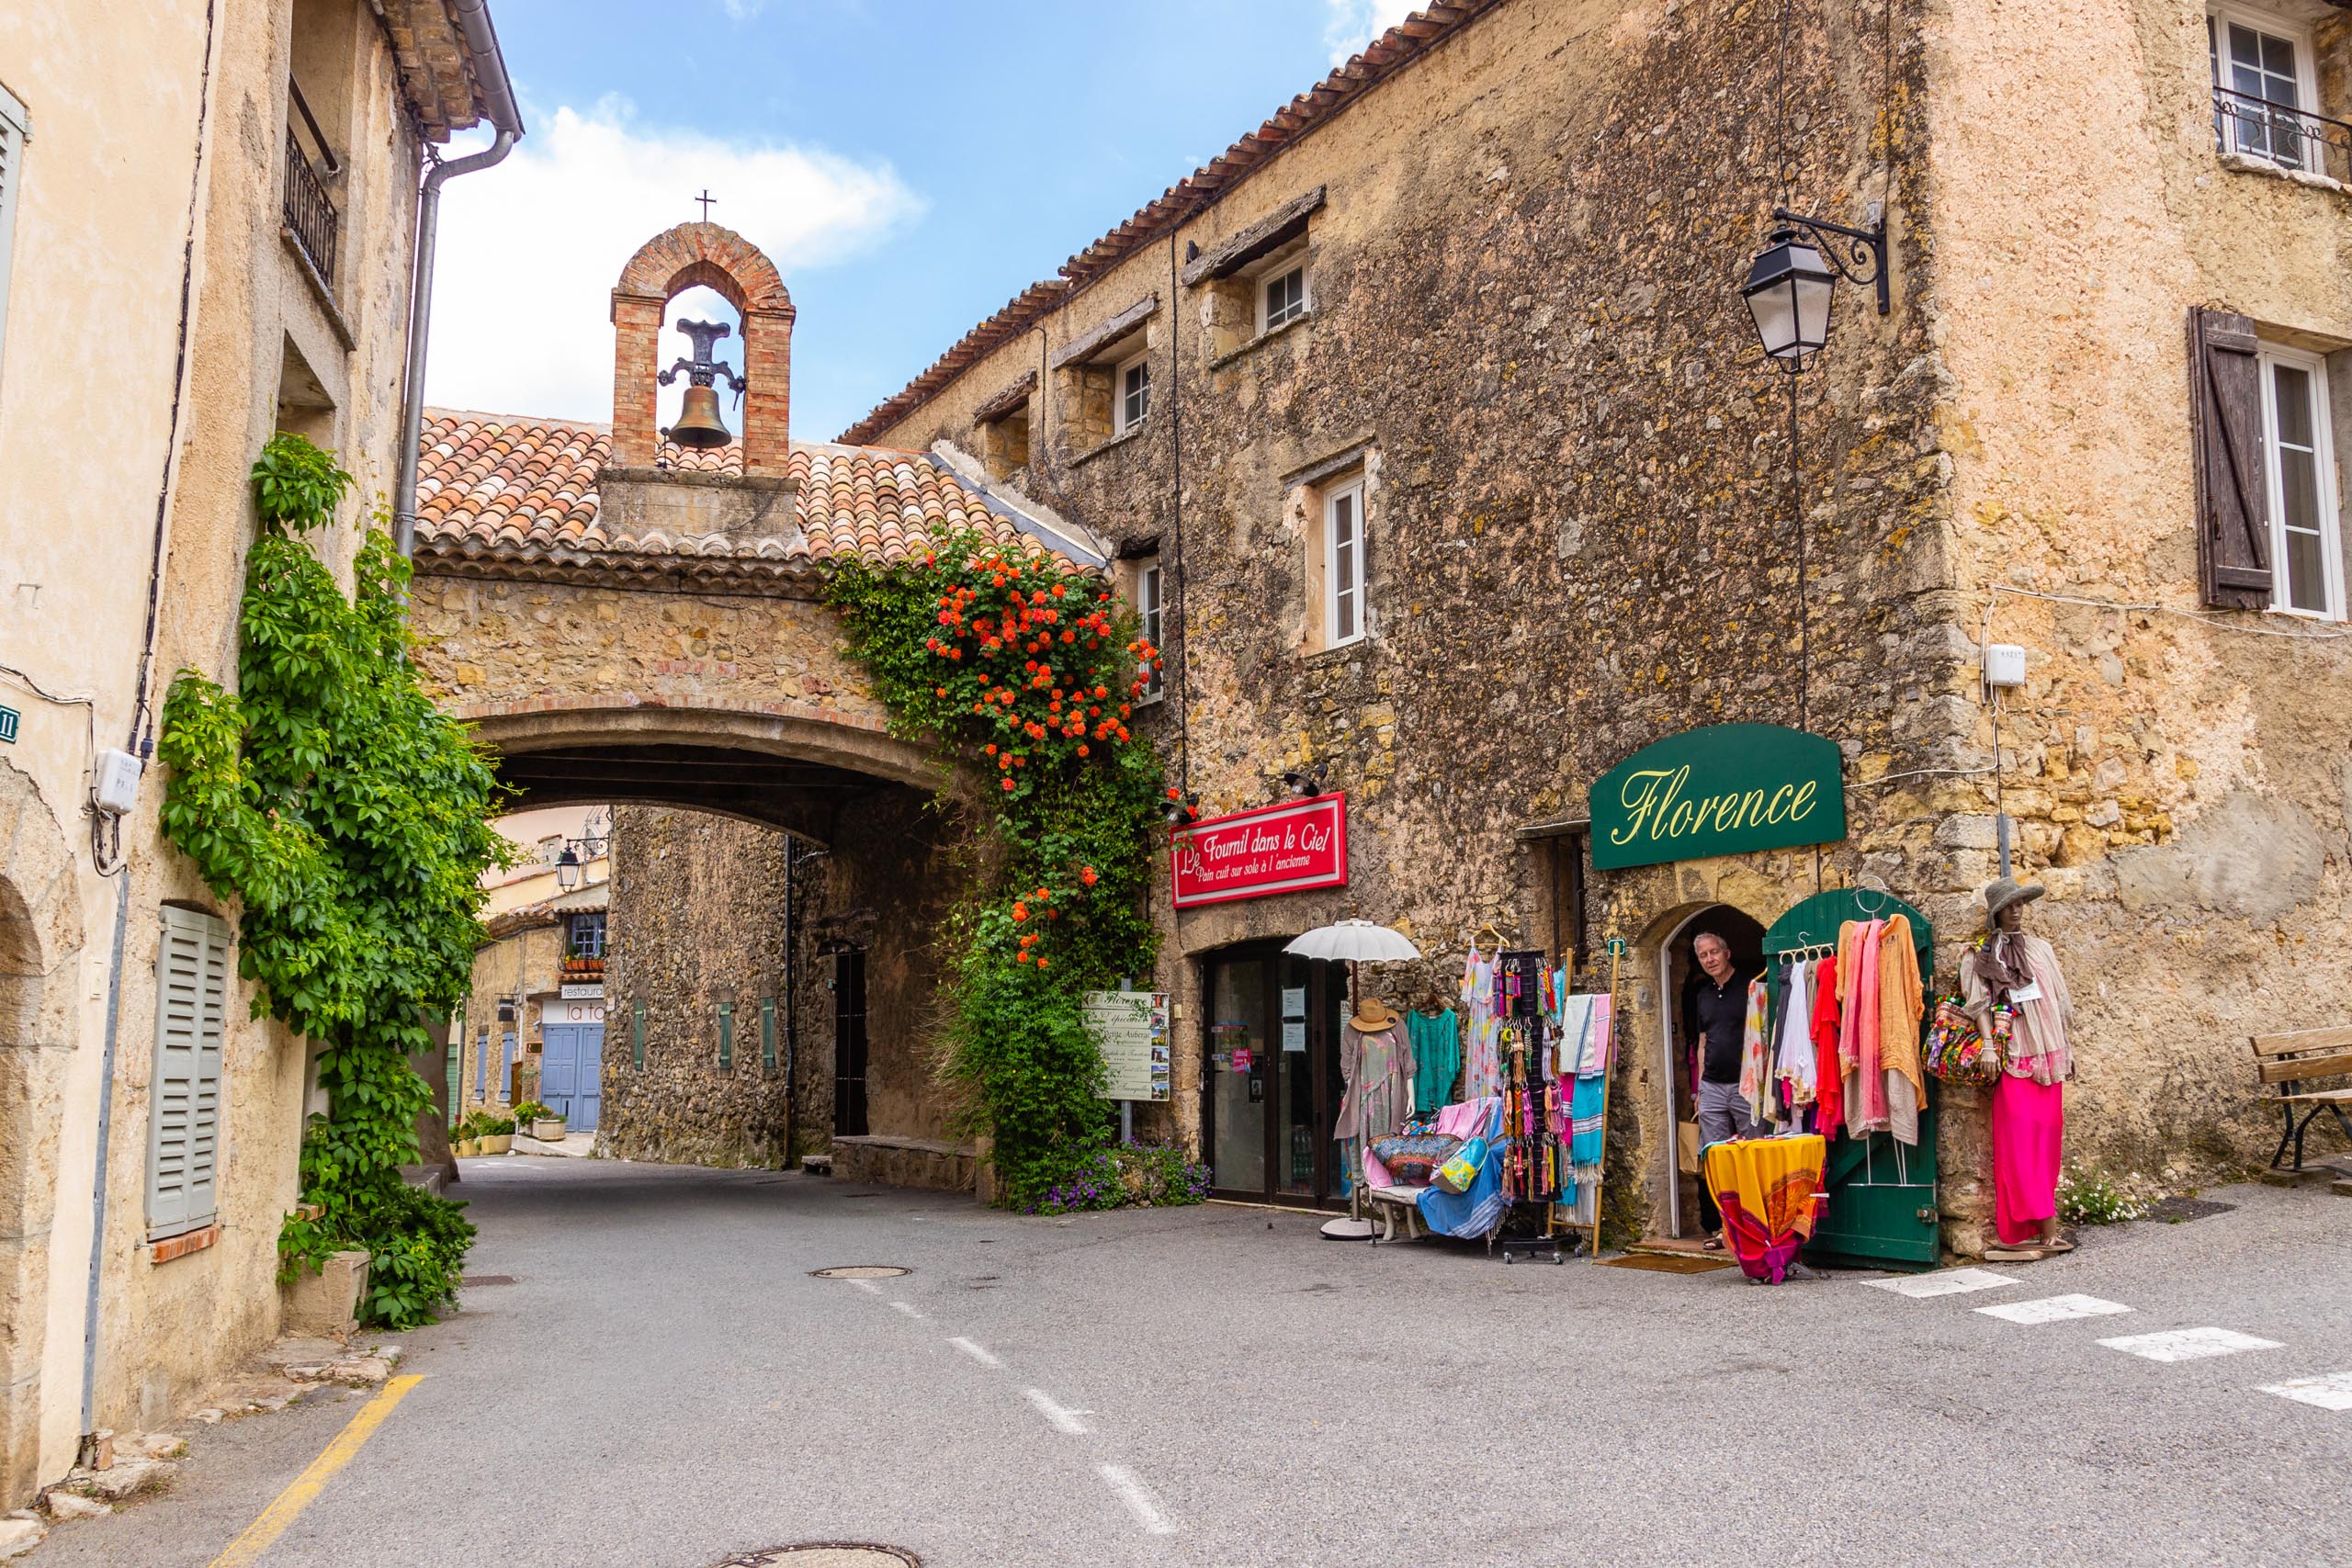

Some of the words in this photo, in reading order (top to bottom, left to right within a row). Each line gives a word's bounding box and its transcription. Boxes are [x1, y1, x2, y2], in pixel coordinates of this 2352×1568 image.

[0, 714, 14, 737] 11
[1611, 764, 1816, 845] Florence
[1181, 845, 1200, 875] Le
[1204, 829, 1250, 862] Fournil
[1251, 827, 1280, 853] dans
[1283, 823, 1295, 851] le
[1301, 822, 1331, 852] Ciel
[1195, 866, 1214, 883] Pain
[1216, 864, 1229, 880] cuit
[1231, 866, 1243, 878] sur
[1244, 857, 1259, 875] sole
[1261, 860, 1267, 873] à
[564, 987, 603, 997] restaura
[567, 1002, 582, 1021] la
